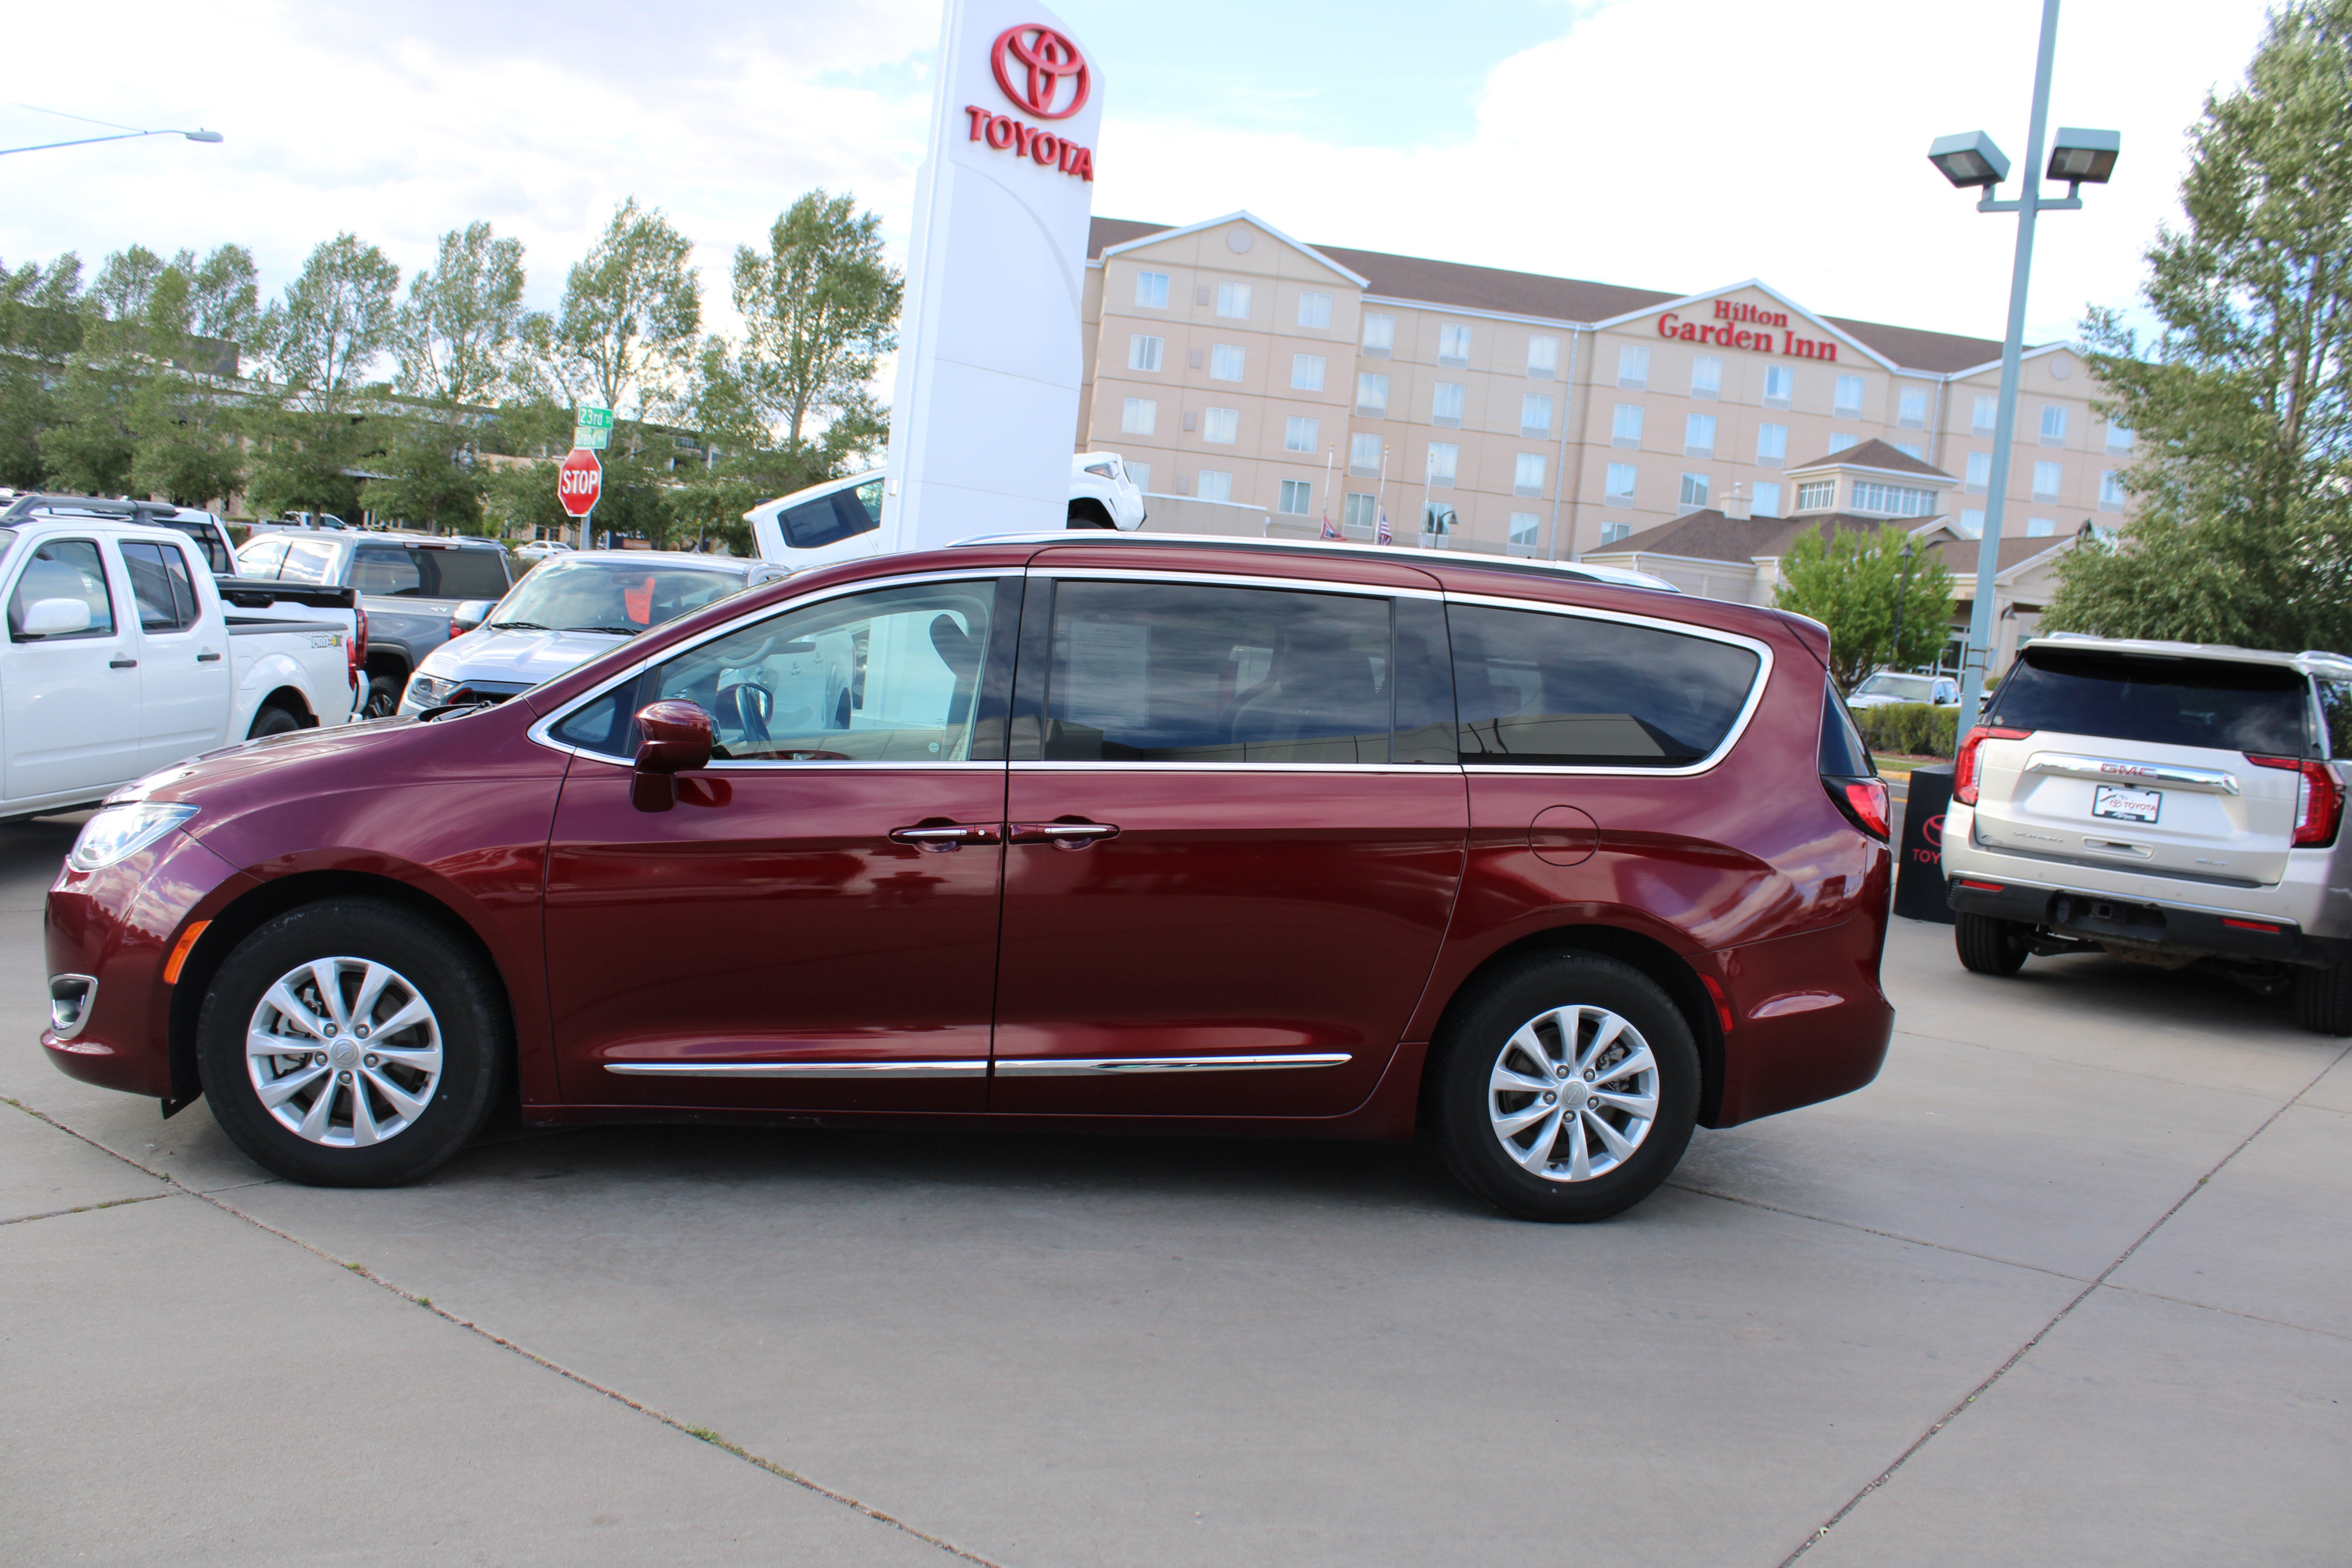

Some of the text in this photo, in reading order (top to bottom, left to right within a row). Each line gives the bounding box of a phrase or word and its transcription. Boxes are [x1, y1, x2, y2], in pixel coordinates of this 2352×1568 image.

[966, 105, 1093, 181] TOYOTA
[1714, 299, 1788, 327] Hilton
[1659, 312, 1837, 361] Garden Inn
[580, 408, 603, 426] 23rd
[562, 470, 598, 494] STOP
[2101, 763, 2156, 777] GMC
[2124, 801, 2158, 811] TOYOTA
[1913, 848, 1942, 864] TOY
